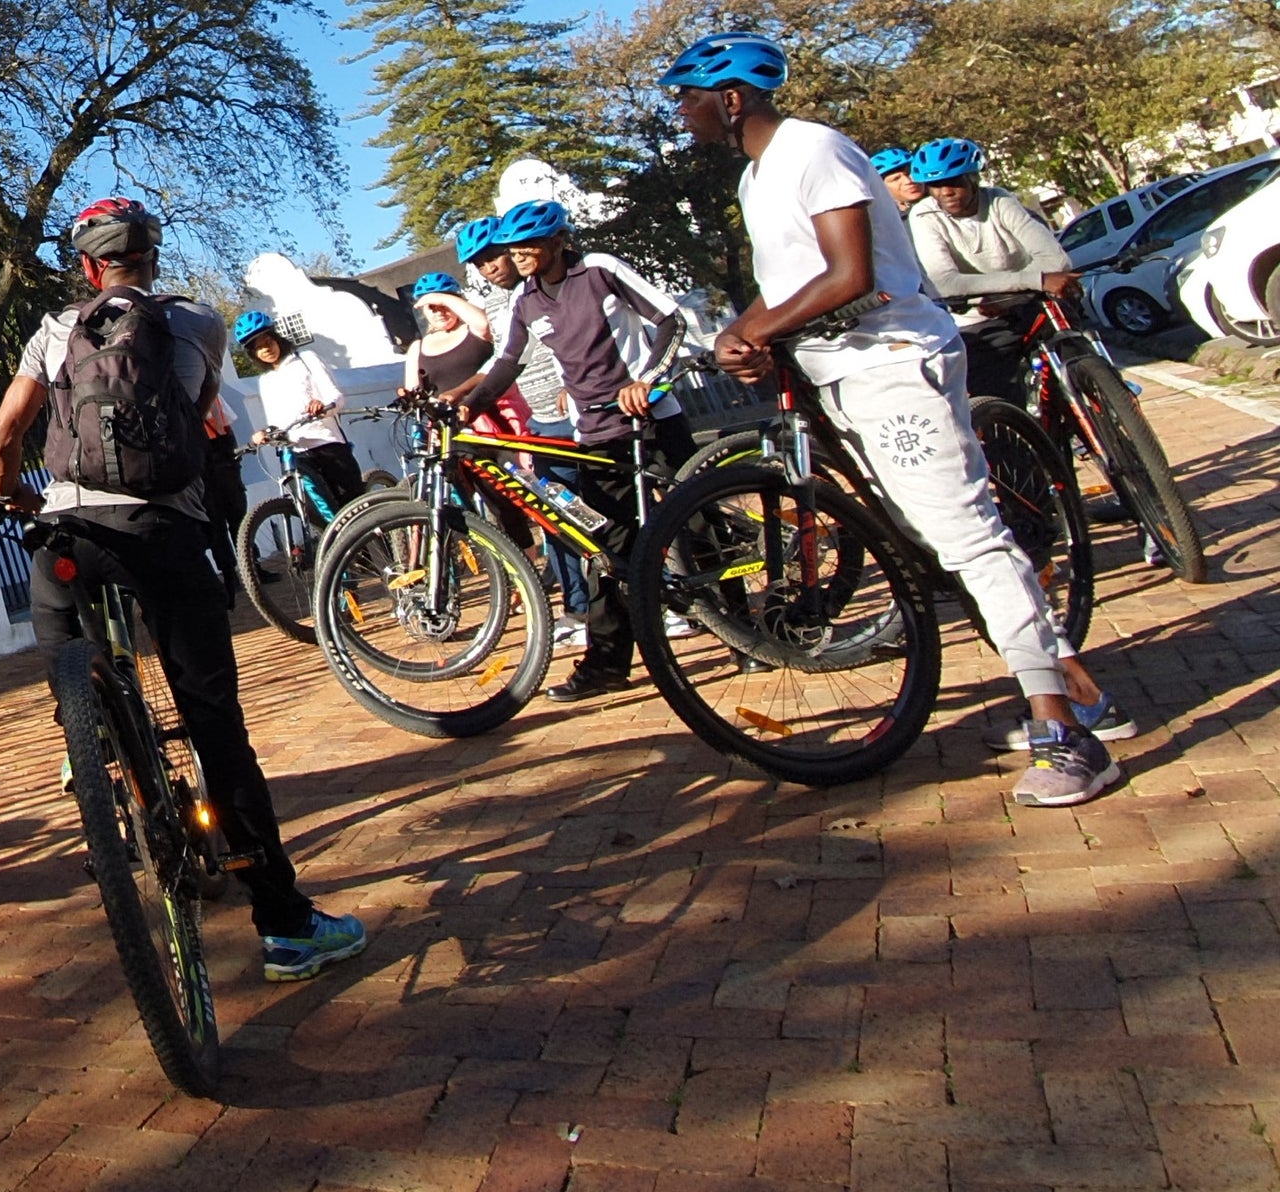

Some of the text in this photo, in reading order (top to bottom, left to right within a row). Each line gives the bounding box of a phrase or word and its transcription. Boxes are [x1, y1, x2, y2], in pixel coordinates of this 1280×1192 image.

[880, 414, 940, 448] REFINERY
[891, 445, 937, 468] DENIM
[478, 458, 566, 525] GIANT
[729, 565, 761, 575] GIANT
[880, 541, 926, 614] MAXXIS
[328, 640, 363, 690] MAXXIS
